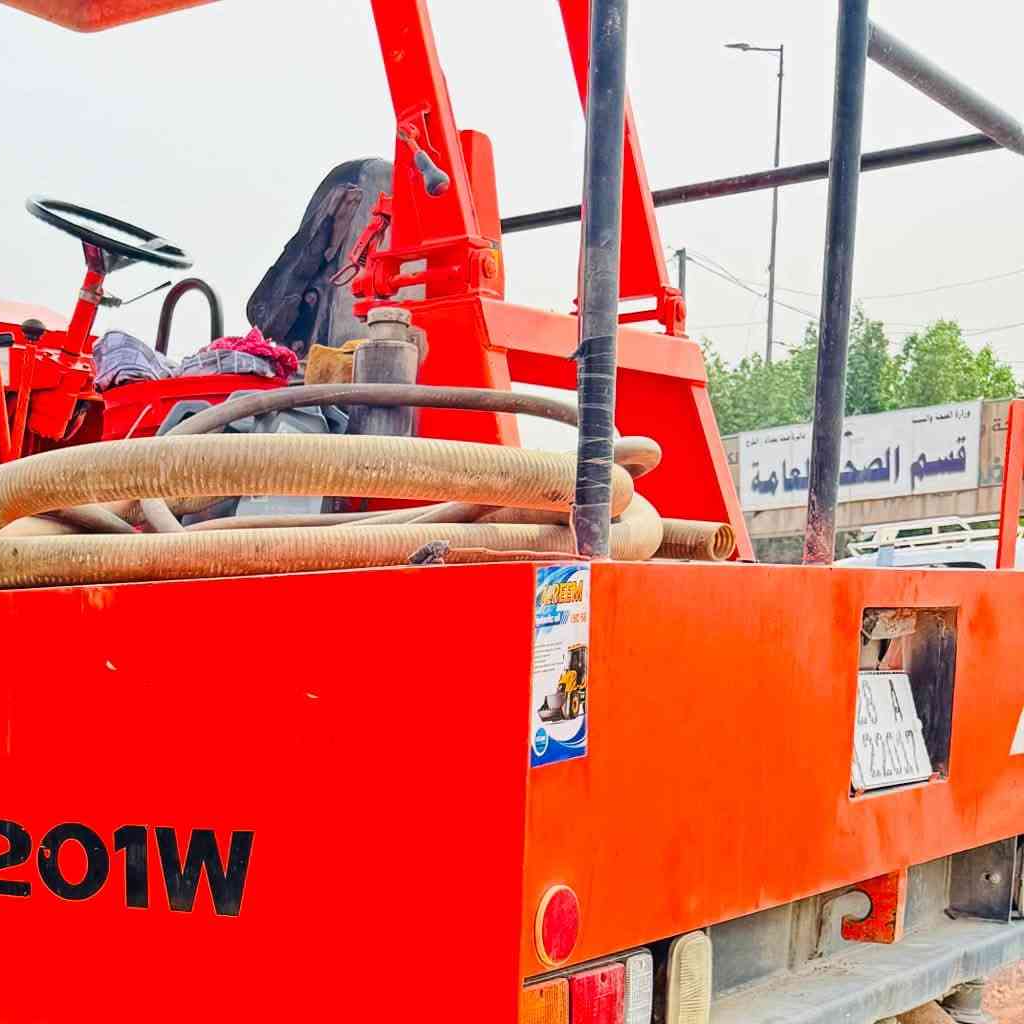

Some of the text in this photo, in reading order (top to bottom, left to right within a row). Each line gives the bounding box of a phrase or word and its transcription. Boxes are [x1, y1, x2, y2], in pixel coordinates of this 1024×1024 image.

[839, 445, 900, 486] الصح
[910, 435, 967, 495] قسم
[888, 679, 904, 722] A
